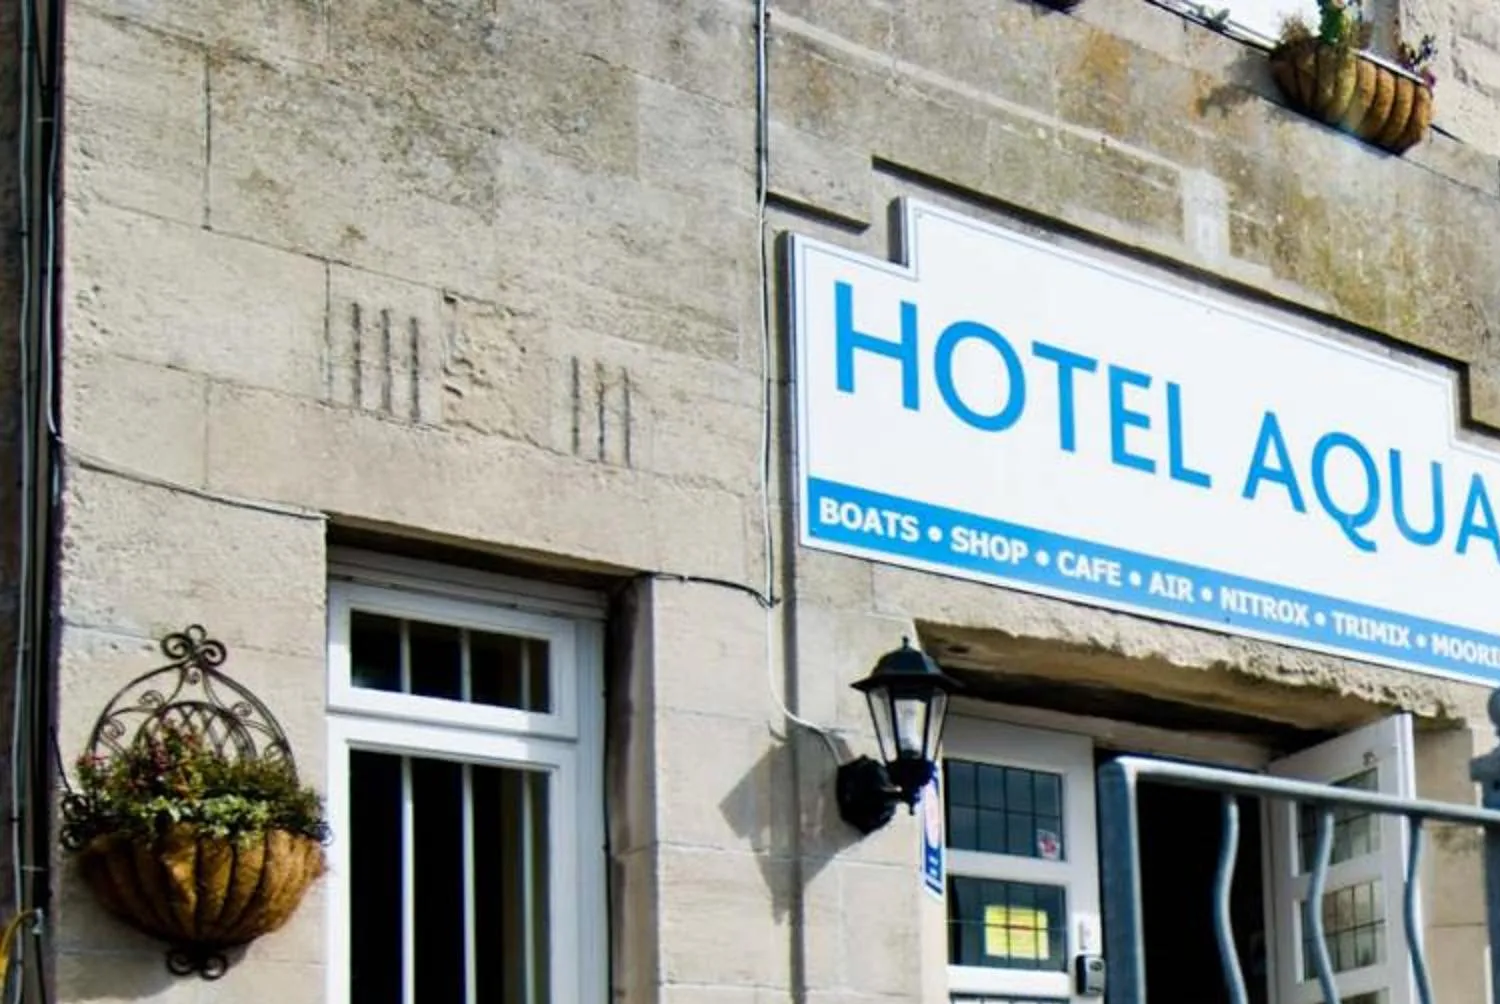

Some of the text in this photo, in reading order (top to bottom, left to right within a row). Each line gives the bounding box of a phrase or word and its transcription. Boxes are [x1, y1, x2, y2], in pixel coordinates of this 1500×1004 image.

[834, 281, 1212, 488] HOTEL
[818, 497, 921, 542] BOATS
[951, 526, 1029, 565] SHOP
[1057, 550, 1123, 587] CAFE
[1149, 571, 1196, 602] AIR
[1219, 586, 1310, 628] NITROX
[1331, 611, 1411, 650] TRIMIX
